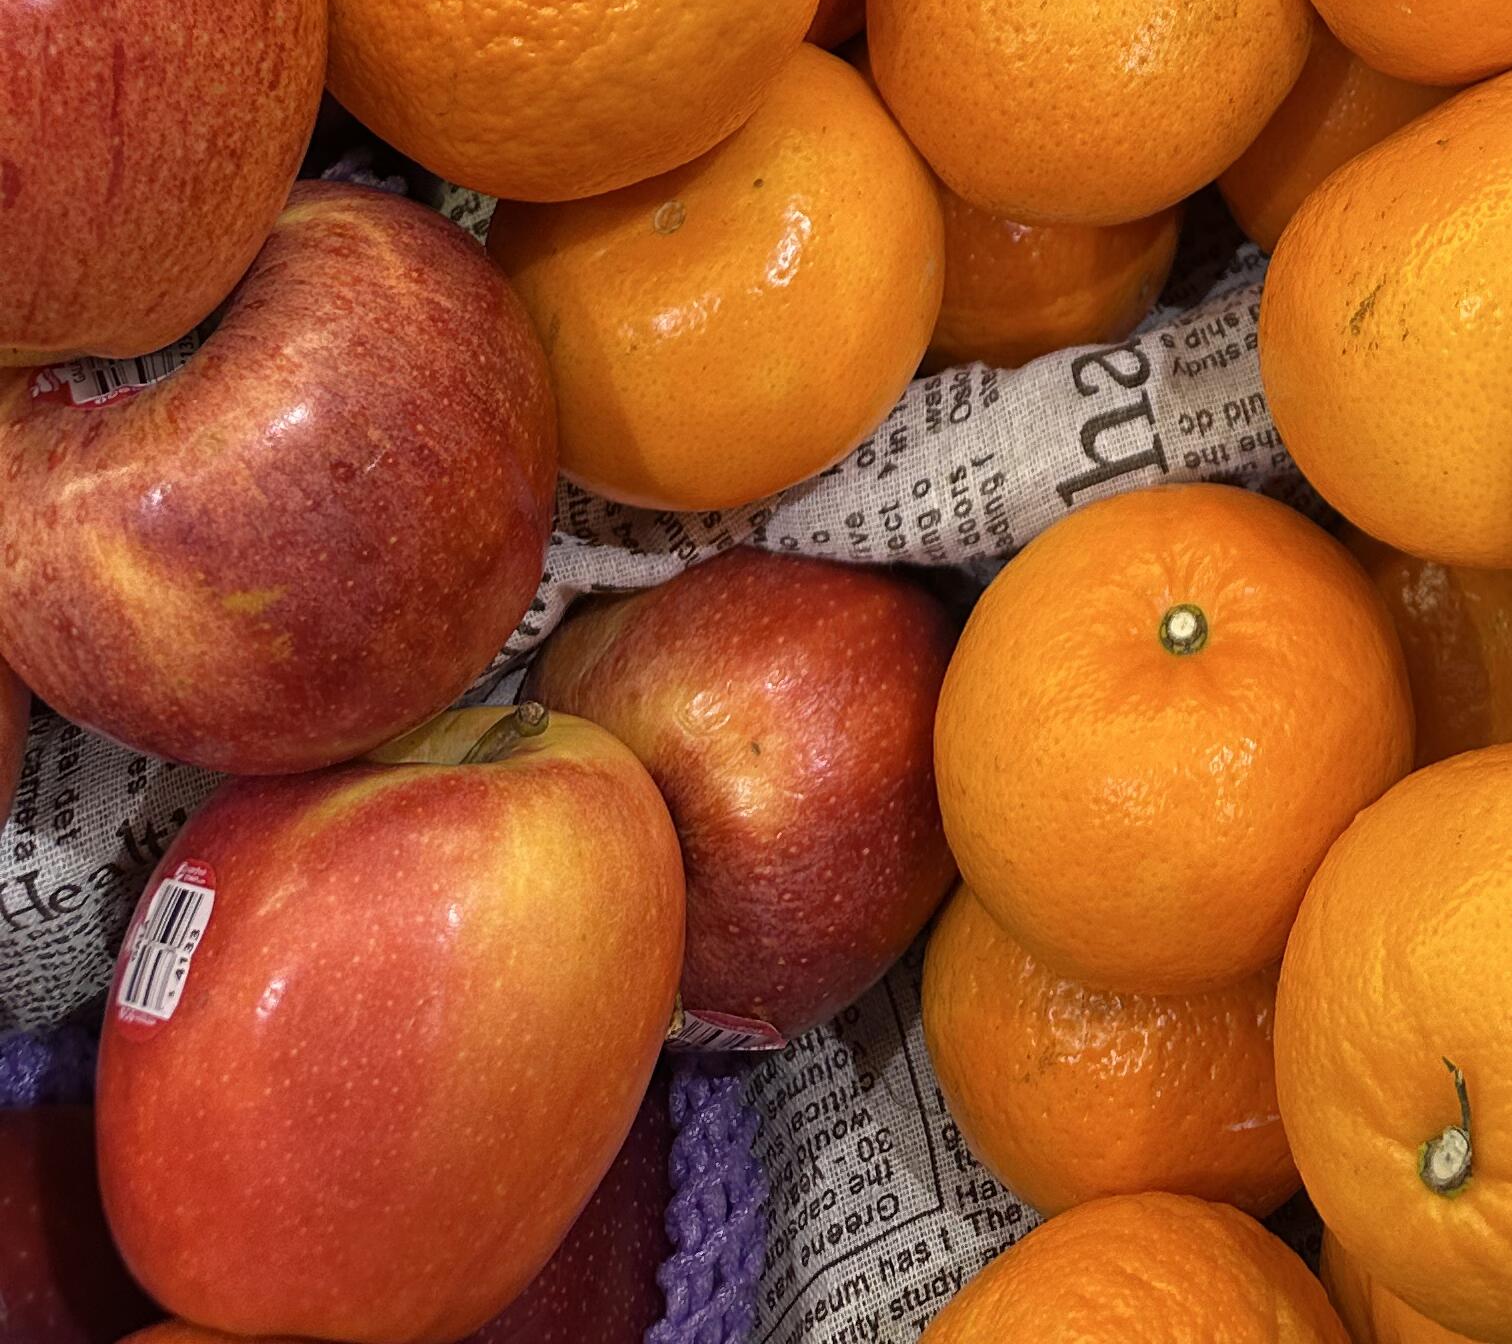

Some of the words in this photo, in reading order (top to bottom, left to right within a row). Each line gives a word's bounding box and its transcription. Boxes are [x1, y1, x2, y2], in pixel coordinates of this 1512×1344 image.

[1173, 343, 1241, 376] study
[0, 808, 188, 932] Healt
[175, 928, 201, 982] 4133
[786, 1071, 875, 1142] critical
[797, 1107, 873, 1164] would
[857, 1127, 893, 1163] 30
[850, 1160, 894, 1196] the
[962, 1203, 1022, 1236] The
[878, 1238, 932, 1290] has
[890, 1266, 965, 1322] study
